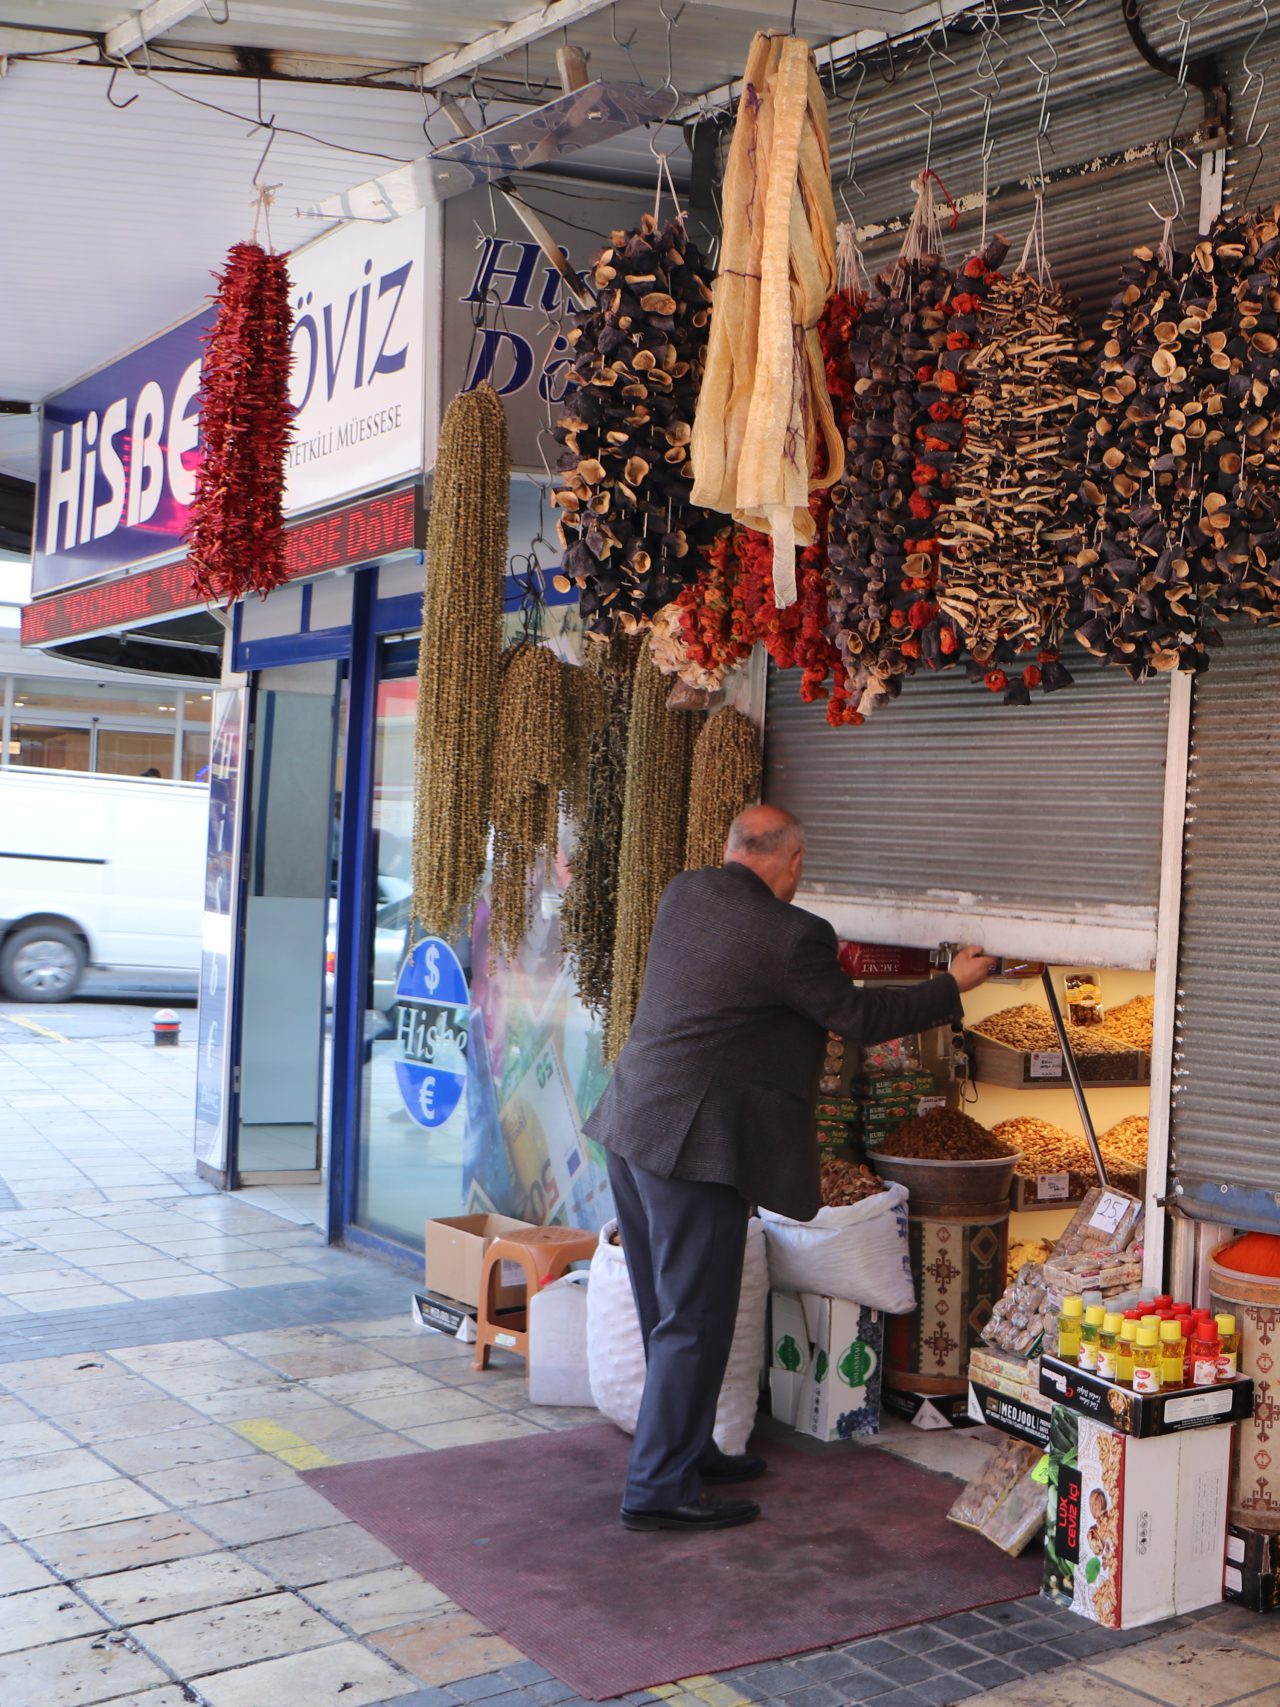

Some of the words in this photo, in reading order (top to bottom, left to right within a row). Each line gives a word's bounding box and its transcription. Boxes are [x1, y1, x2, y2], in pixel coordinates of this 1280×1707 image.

[336, 404, 402, 451] MÜESSESE
[1097, 1198, 1123, 1219] 25
[1001, 1402, 1036, 1430] MEDJOOL
